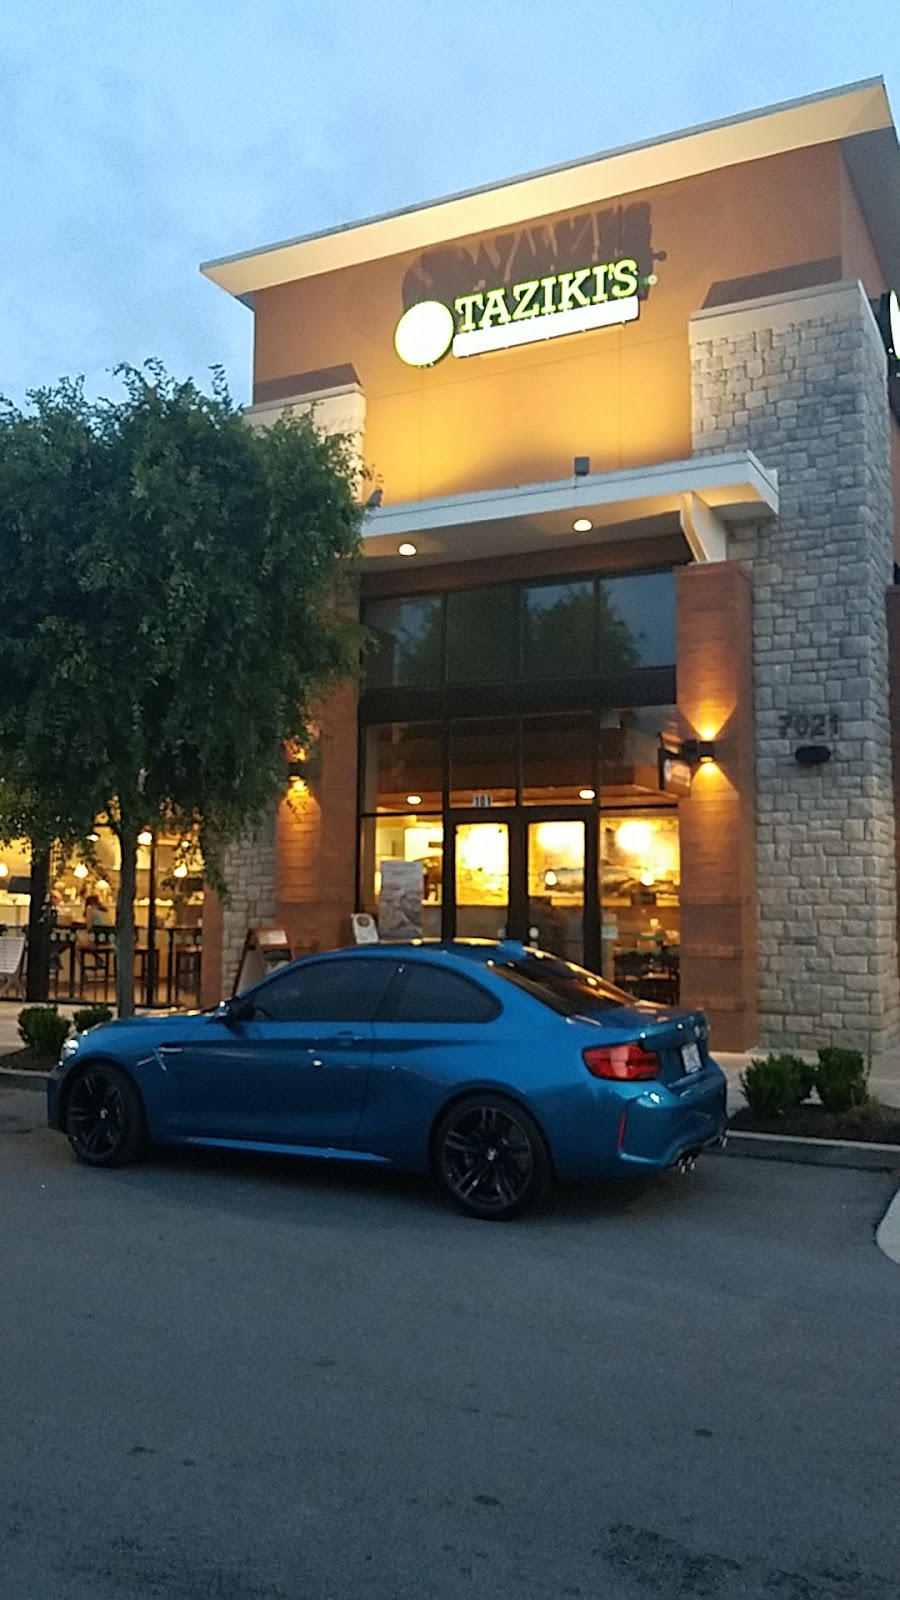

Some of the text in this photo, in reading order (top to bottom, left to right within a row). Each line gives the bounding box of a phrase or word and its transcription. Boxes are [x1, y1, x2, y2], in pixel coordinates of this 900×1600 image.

[454, 258, 638, 332] TAZIKI'S
[778, 713, 838, 739] 7021
[475, 795, 491, 807] 101
